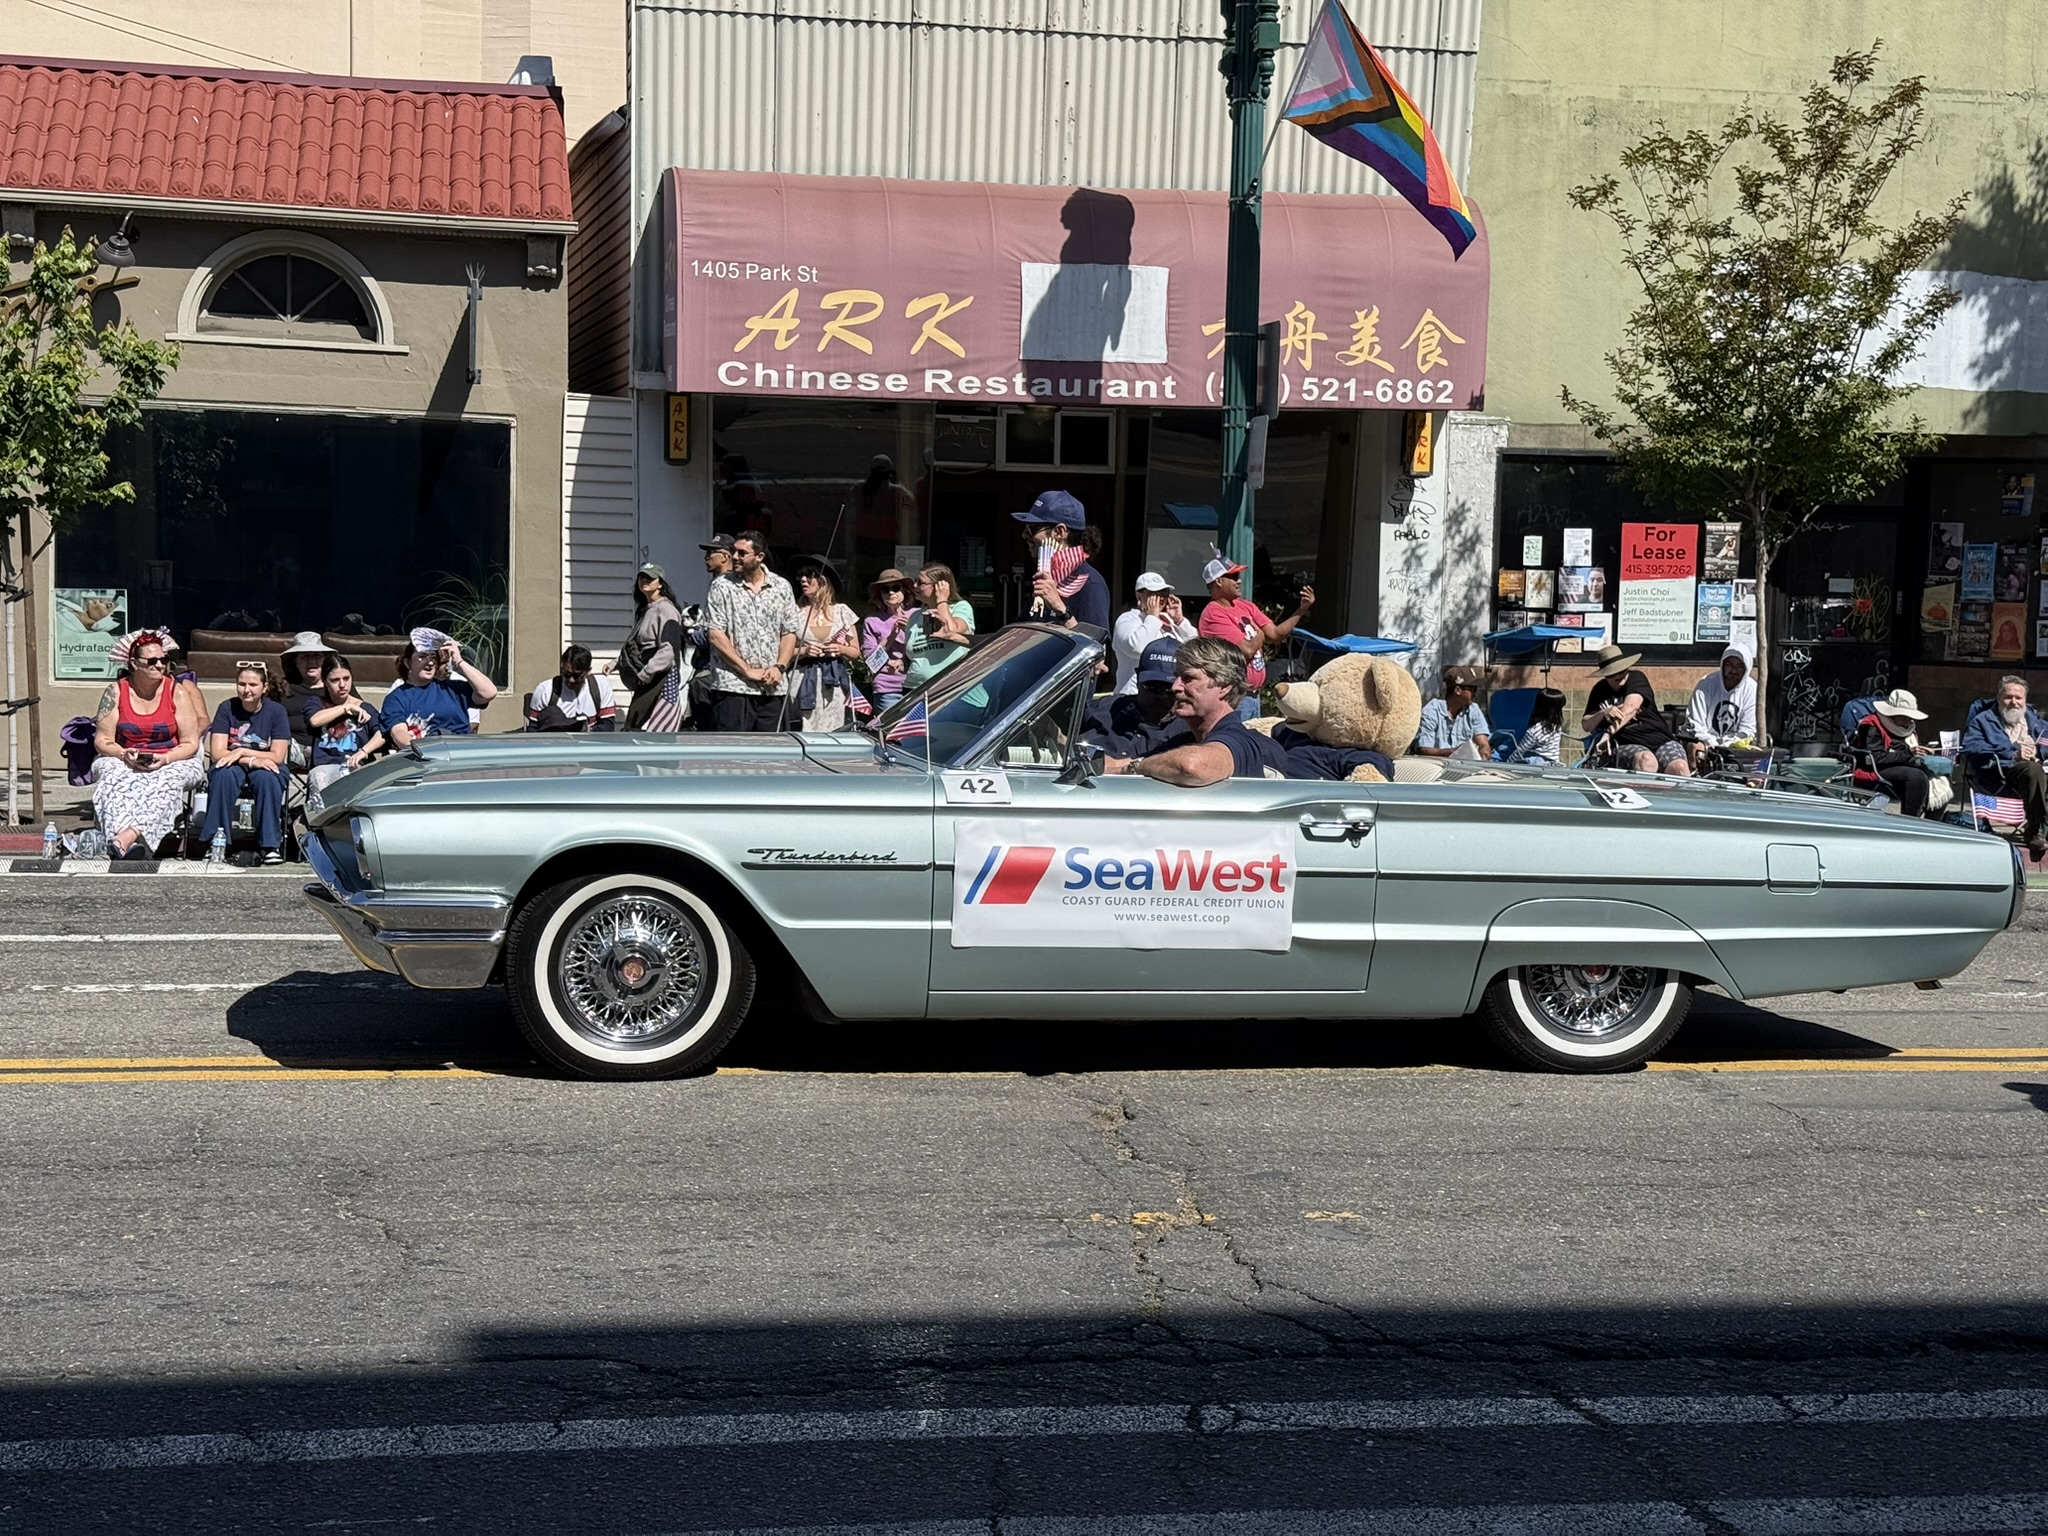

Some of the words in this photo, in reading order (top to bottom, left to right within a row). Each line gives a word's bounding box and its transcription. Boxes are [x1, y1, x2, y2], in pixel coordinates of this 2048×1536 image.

[690, 259, 740, 280] 1405
[745, 262, 792, 283] Park
[796, 265, 819, 283] St
[733, 287, 975, 359] ARK
[717, 360, 909, 392] Chinese
[924, 368, 1177, 400] Restaurant
[1302, 376, 1454, 404] 521-6862
[672, 402, 685, 452] ARK
[1644, 526, 1677, 542] For
[1632, 543, 1687, 560] Lease
[1625, 564, 1692, 575] 415.395.7262
[1622, 587, 1648, 596] Justin
[1650, 587, 1670, 596] Choi
[1621, 608, 1638, 616] Jeff
[1639, 608, 1684, 616] Badstubner
[1678, 632, 1691, 641] JLL
[960, 778, 997, 794] 42
[747, 848, 898, 861] Thunderbird
[1063, 846, 1288, 893] SeaWest
[1062, 895, 1101, 906] COAST
[1104, 896, 1146, 907] GUARD
[1150, 897, 1200, 908] FEDERAL
[1203, 897, 1243, 908] CREDIT
[1246, 899, 1285, 909] UNION
[1113, 912, 1230, 925] www.seawest.coop
